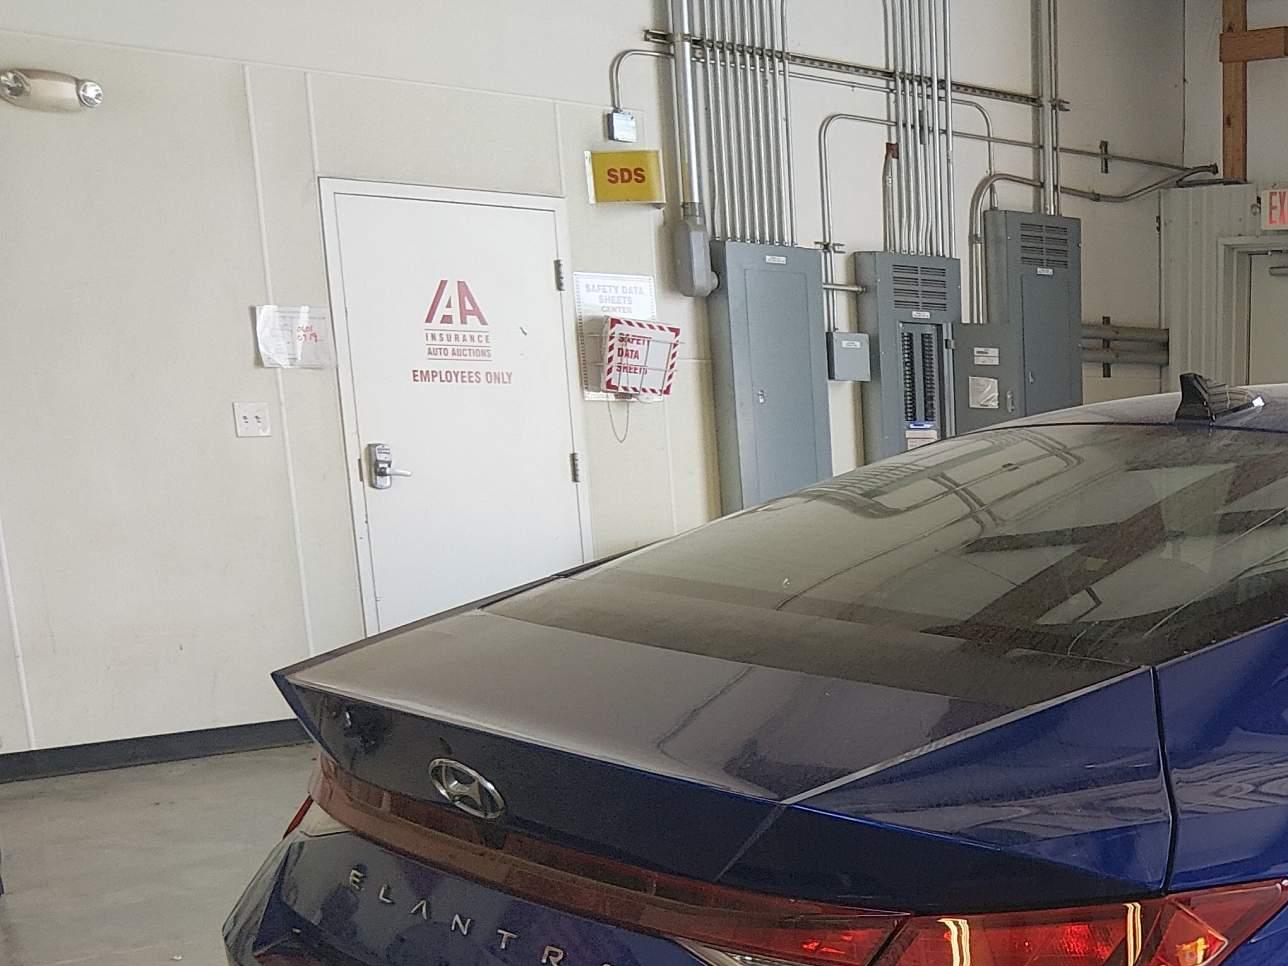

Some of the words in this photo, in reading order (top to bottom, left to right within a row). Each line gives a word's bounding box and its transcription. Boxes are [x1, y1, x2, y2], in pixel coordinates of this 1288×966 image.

[607, 167, 646, 185] SDS
[585, 284, 619, 294] SAFETY
[622, 285, 645, 296] DATA
[598, 294, 633, 305] SHEETS
[425, 332, 491, 344] INSURANCE
[427, 347, 449, 357] AUTO
[451, 348, 492, 358] AUCTIONS
[617, 347, 640, 360] DATA
[412, 369, 481, 384] EMPLOYEES
[485, 371, 513, 385] ONLY
